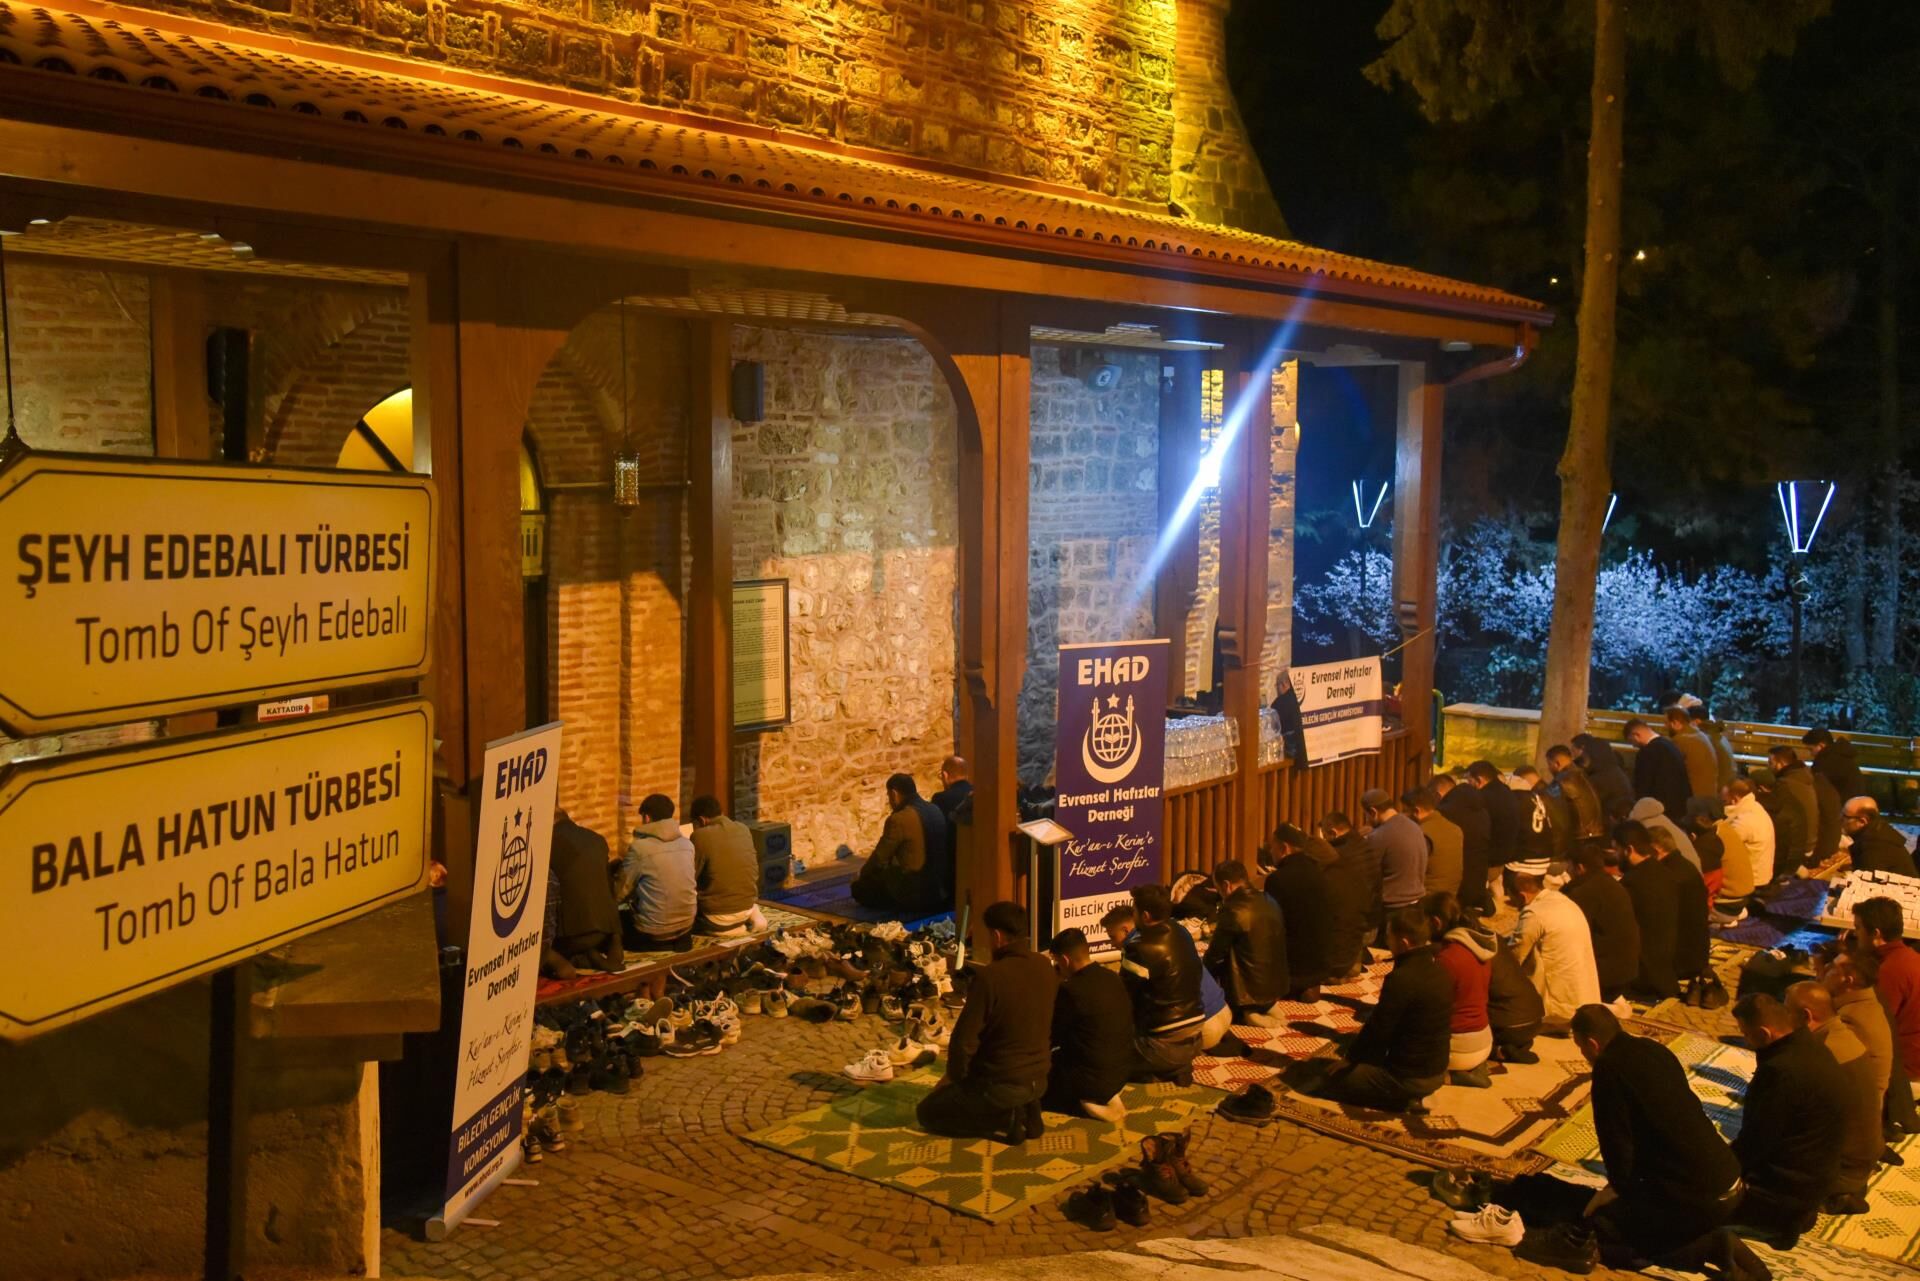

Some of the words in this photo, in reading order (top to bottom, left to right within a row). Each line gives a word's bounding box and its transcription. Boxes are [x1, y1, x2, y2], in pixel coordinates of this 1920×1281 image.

[17, 534, 130, 598] ŞEYH
[144, 532, 286, 580] EDEBALI
[296, 522, 410, 575] TÜRBESİ
[76, 611, 180, 665] Tomb
[192, 606, 230, 654] Of
[239, 603, 308, 661] Şeyh
[319, 596, 407, 642] Edebalı
[1078, 655, 1150, 688] EHAD
[1311, 668, 1342, 685] Evrensel
[1344, 666, 1372, 680] Hafızlar
[1327, 684, 1355, 698] Derneği
[495, 747, 548, 800] EHAD
[1058, 789, 1110, 808] Evrensel
[1113, 785, 1160, 803] Hafızlar
[1087, 805, 1134, 823] Derneği
[31, 823, 145, 894] BALA
[156, 791, 276, 861] HATUN
[284, 750, 401, 826] TÜRBESİ
[95, 882, 196, 951] Tomb
[208, 864, 245, 916] Of
[254, 848, 314, 902] Bala
[324, 829, 400, 879] Hatun
[1069, 859, 1106, 878] Hizmet
[1063, 900, 1105, 919] BİLECİK
[467, 948, 505, 988] Evrensel
[507, 930, 540, 964] Hafızlar
[487, 964, 520, 1000] Derneği
[458, 1113, 489, 1154] BİLECİK
[489, 1086, 520, 1120] GENÇLİK
[463, 1121, 511, 1177] KOMİSYONU
